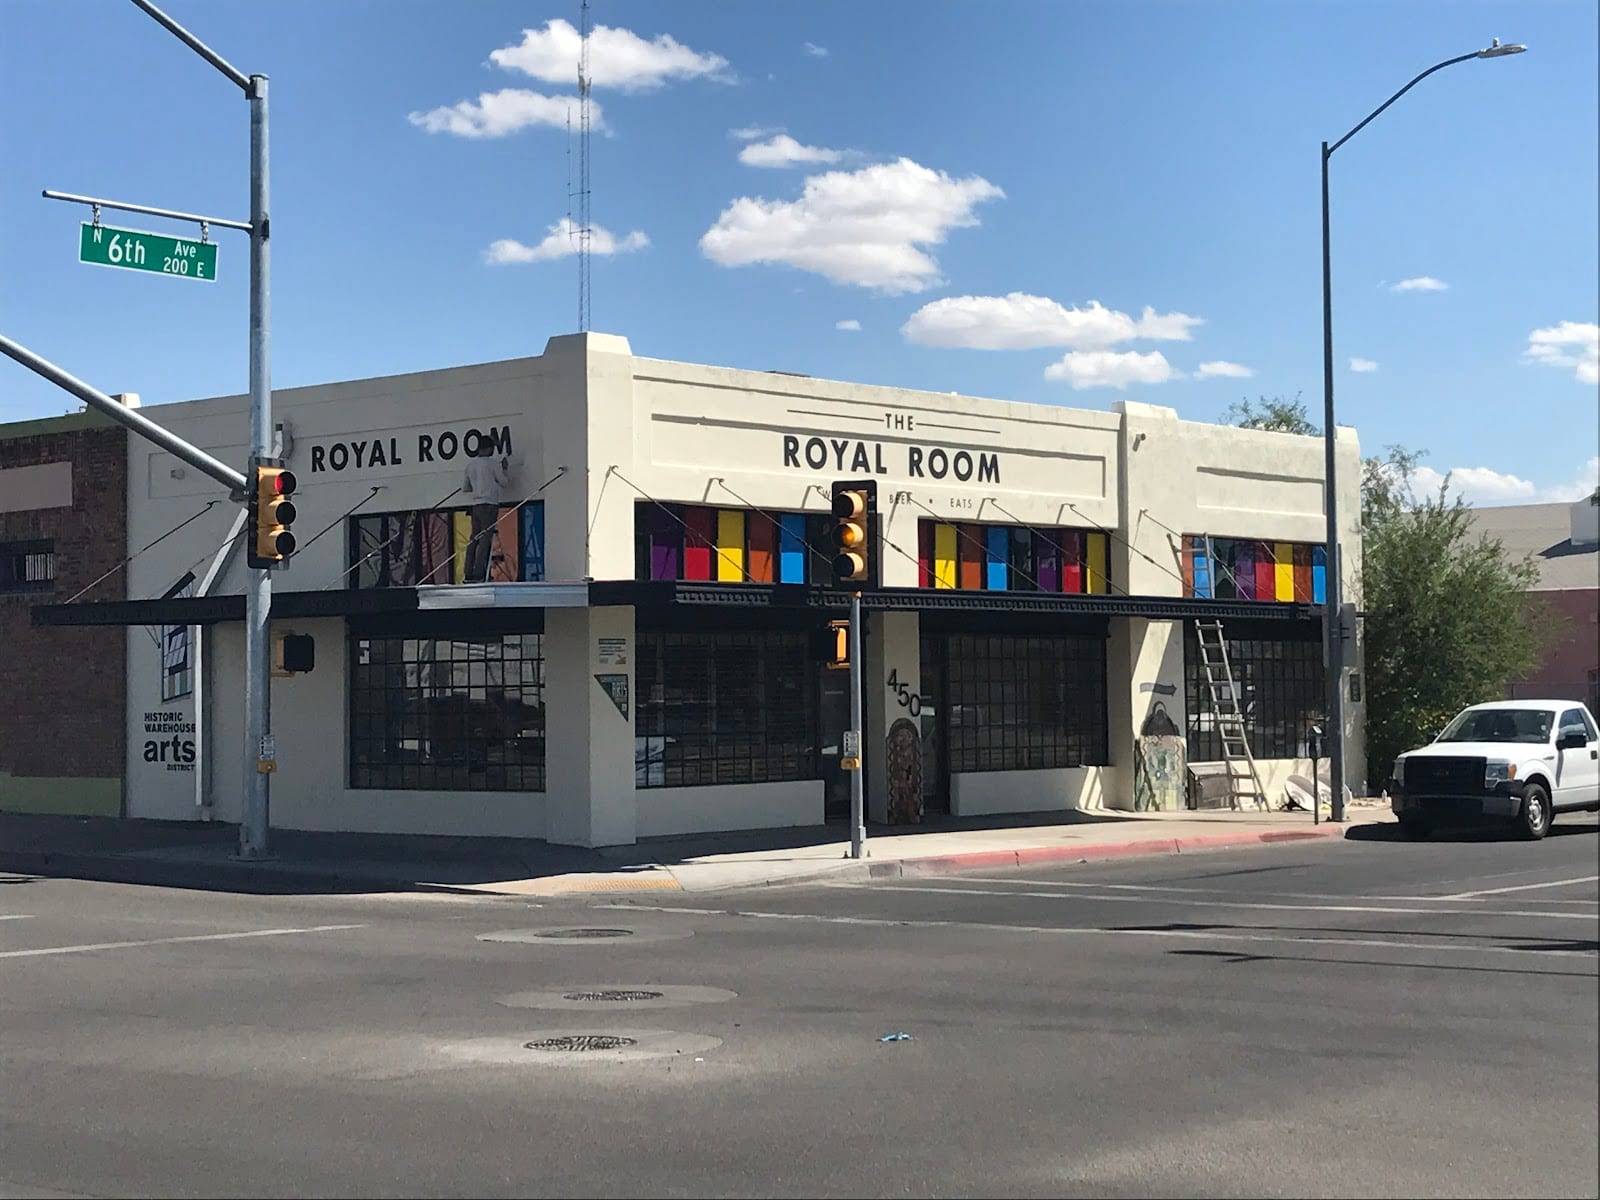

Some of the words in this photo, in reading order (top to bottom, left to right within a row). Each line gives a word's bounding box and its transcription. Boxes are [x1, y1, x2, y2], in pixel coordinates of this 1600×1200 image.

[94, 228, 102, 243] N
[108, 233, 146, 264] 6th
[174, 241, 197, 258] Ave
[163, 257, 188, 275] 200
[197, 262, 204, 277] E
[885, 413, 914, 431] THE
[311, 438, 402, 473] ROYAL
[418, 426, 512, 463] ROOM
[783, 435, 888, 475] ROYAL
[908, 446, 1000, 484] ROOM
[950, 498, 973, 509] EATS
[887, 668, 920, 717] 450
[144, 712, 182, 721] HISTORIC
[144, 723, 196, 732] WAREHOUSE
[143, 734, 196, 763] arts
[167, 763, 195, 771] DISTRICT
